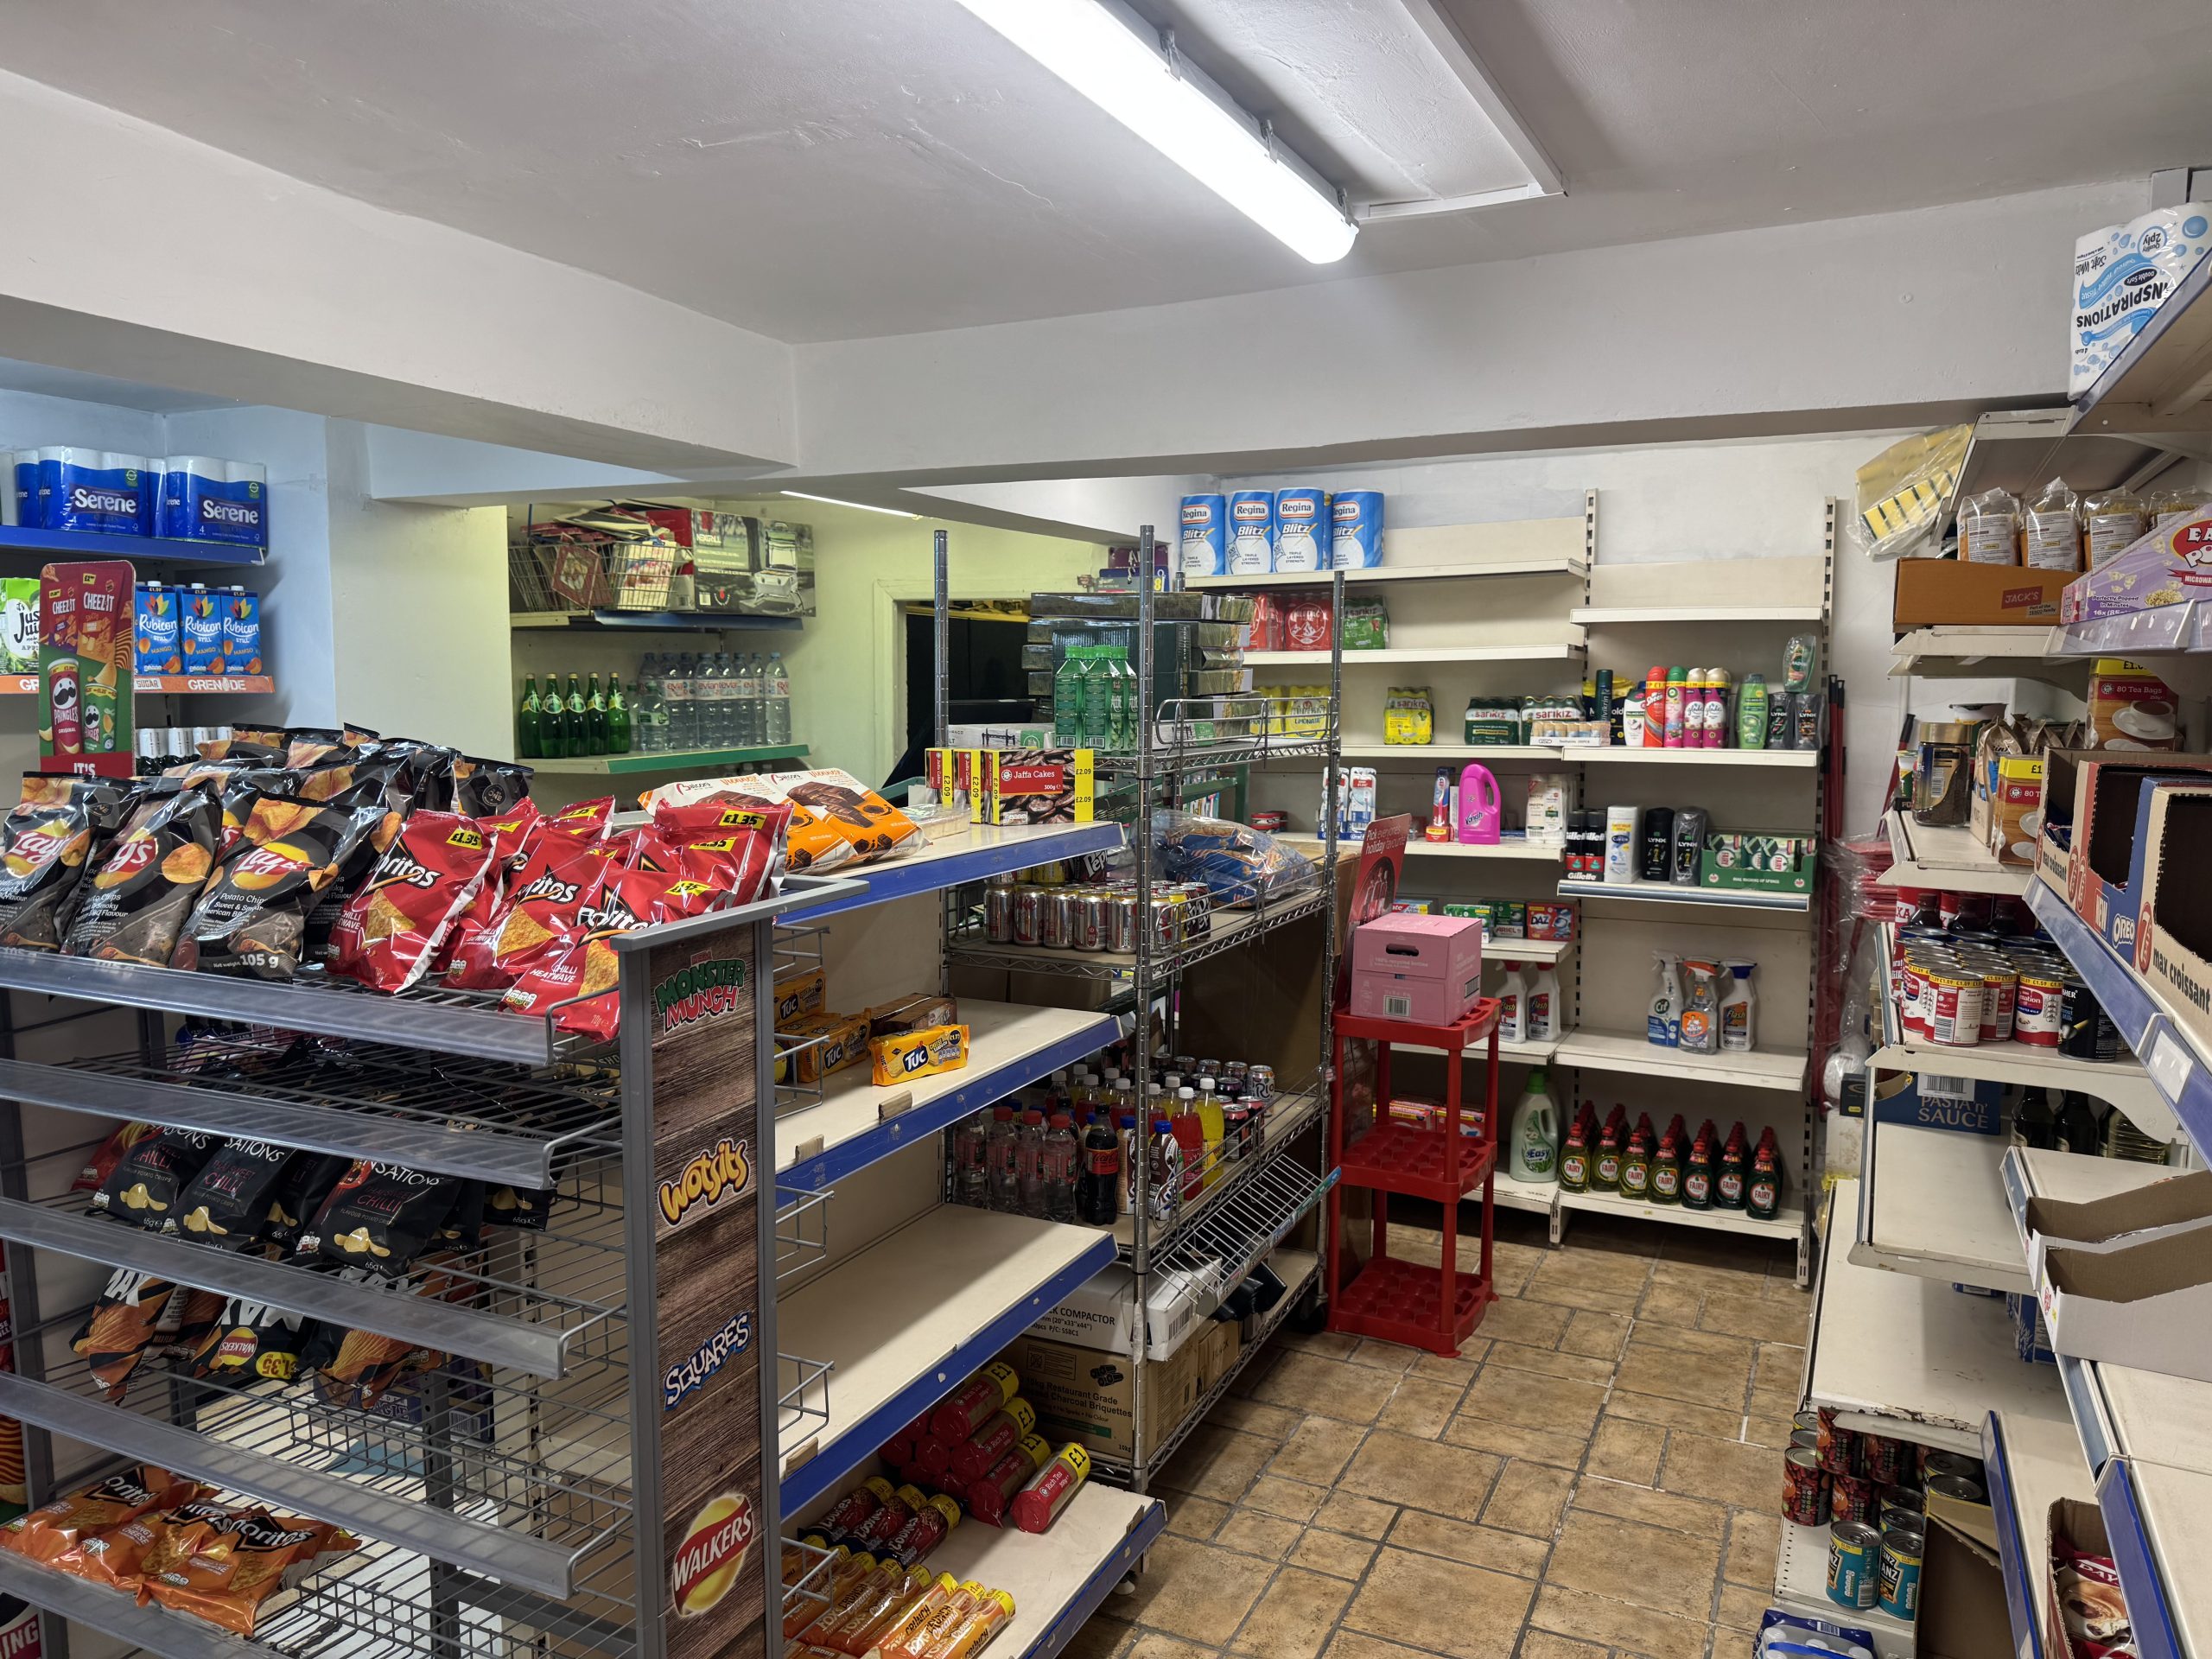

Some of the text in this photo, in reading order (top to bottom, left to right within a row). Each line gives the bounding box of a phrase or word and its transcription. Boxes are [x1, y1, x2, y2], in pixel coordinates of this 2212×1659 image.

[2143, 232, 2161, 245] 2ply
[74, 487, 137, 513] Serene
[203, 499, 258, 524] Serene
[1236, 505, 1266, 518] Regina
[1282, 503, 1312, 515] Regina
[1237, 525, 1265, 536] Blitz
[1281, 523, 1310, 534] Blitz
[2005, 590, 2039, 604] JACK'S
[139, 613, 178, 632] Rubicon
[185, 615, 222, 632] Rubicon
[223, 617, 259, 633] Rubicon
[2143, 686, 2162, 696] Bags
[54, 706, 79, 725] PRINGLES
[1014, 770, 1032, 779] Jaffa
[723, 814, 753, 825] £1.35
[452, 830, 480, 846] £1.35
[1367, 830, 1377, 841] Pick
[1365, 840, 1386, 855] holiday
[1567, 871, 1597, 882] Gillette
[2049, 855, 2067, 883] croissant
[213, 901, 235, 910] Sweet
[219, 893, 245, 902] Potato
[1530, 916, 1549, 925] DAZ
[2095, 893, 2109, 932] NEW
[2113, 915, 2135, 946] OREO
[239, 954, 266, 967] 105
[529, 968, 577, 982] HEATWAVE
[2152, 947, 2211, 1016] max croissant
[656, 959, 746, 1009] MONSTER
[664, 985, 737, 1032] MUNCH
[781, 996, 798, 1018] TUC
[1655, 1001, 1669, 1013] Cif
[825, 1046, 842, 1067] TUC
[905, 1050, 926, 1071] TUC
[1917, 1109, 1989, 1130] SAUCE
[1565, 1163, 1580, 1174] FAIRY
[1601, 1164, 1616, 1174] FAIRY
[1627, 1170, 1643, 1181] FAIRY
[1657, 1174, 1674, 1185] FAIRY
[1688, 1181, 1706, 1192] FAIRY
[1721, 1180, 1738, 1191] FAIRY
[357, 1194, 401, 1213] CHILLI
[1754, 1190, 1771, 1201] FAIRY
[365, 1261, 379, 1271] 65g
[1060, 1307, 1116, 1325] COMPACTOR
[219, 1340, 256, 1354] WALKERS
[665, 1313, 750, 1407] SQUARES
[992, 1365, 1012, 1381] £1
[1046, 1382, 1091, 1399] Restaurant
[1092, 1392, 1119, 1405] Grade
[1051, 1390, 1133, 1418] Charcoal Briquettes
[1019, 1407, 1034, 1428] £1
[991, 1437, 1001, 1450] Rich
[1021, 1435, 1041, 1452] £1
[1068, 1447, 1087, 1469] £1
[1046, 1471, 1063, 1491] Rich Tea
[122, 1527, 149, 1545] CHEESE
[130, 1522, 156, 1539] TANGY
[674, 1508, 753, 1590] WALKERS
[905, 1604, 931, 1637] CRUNCH
